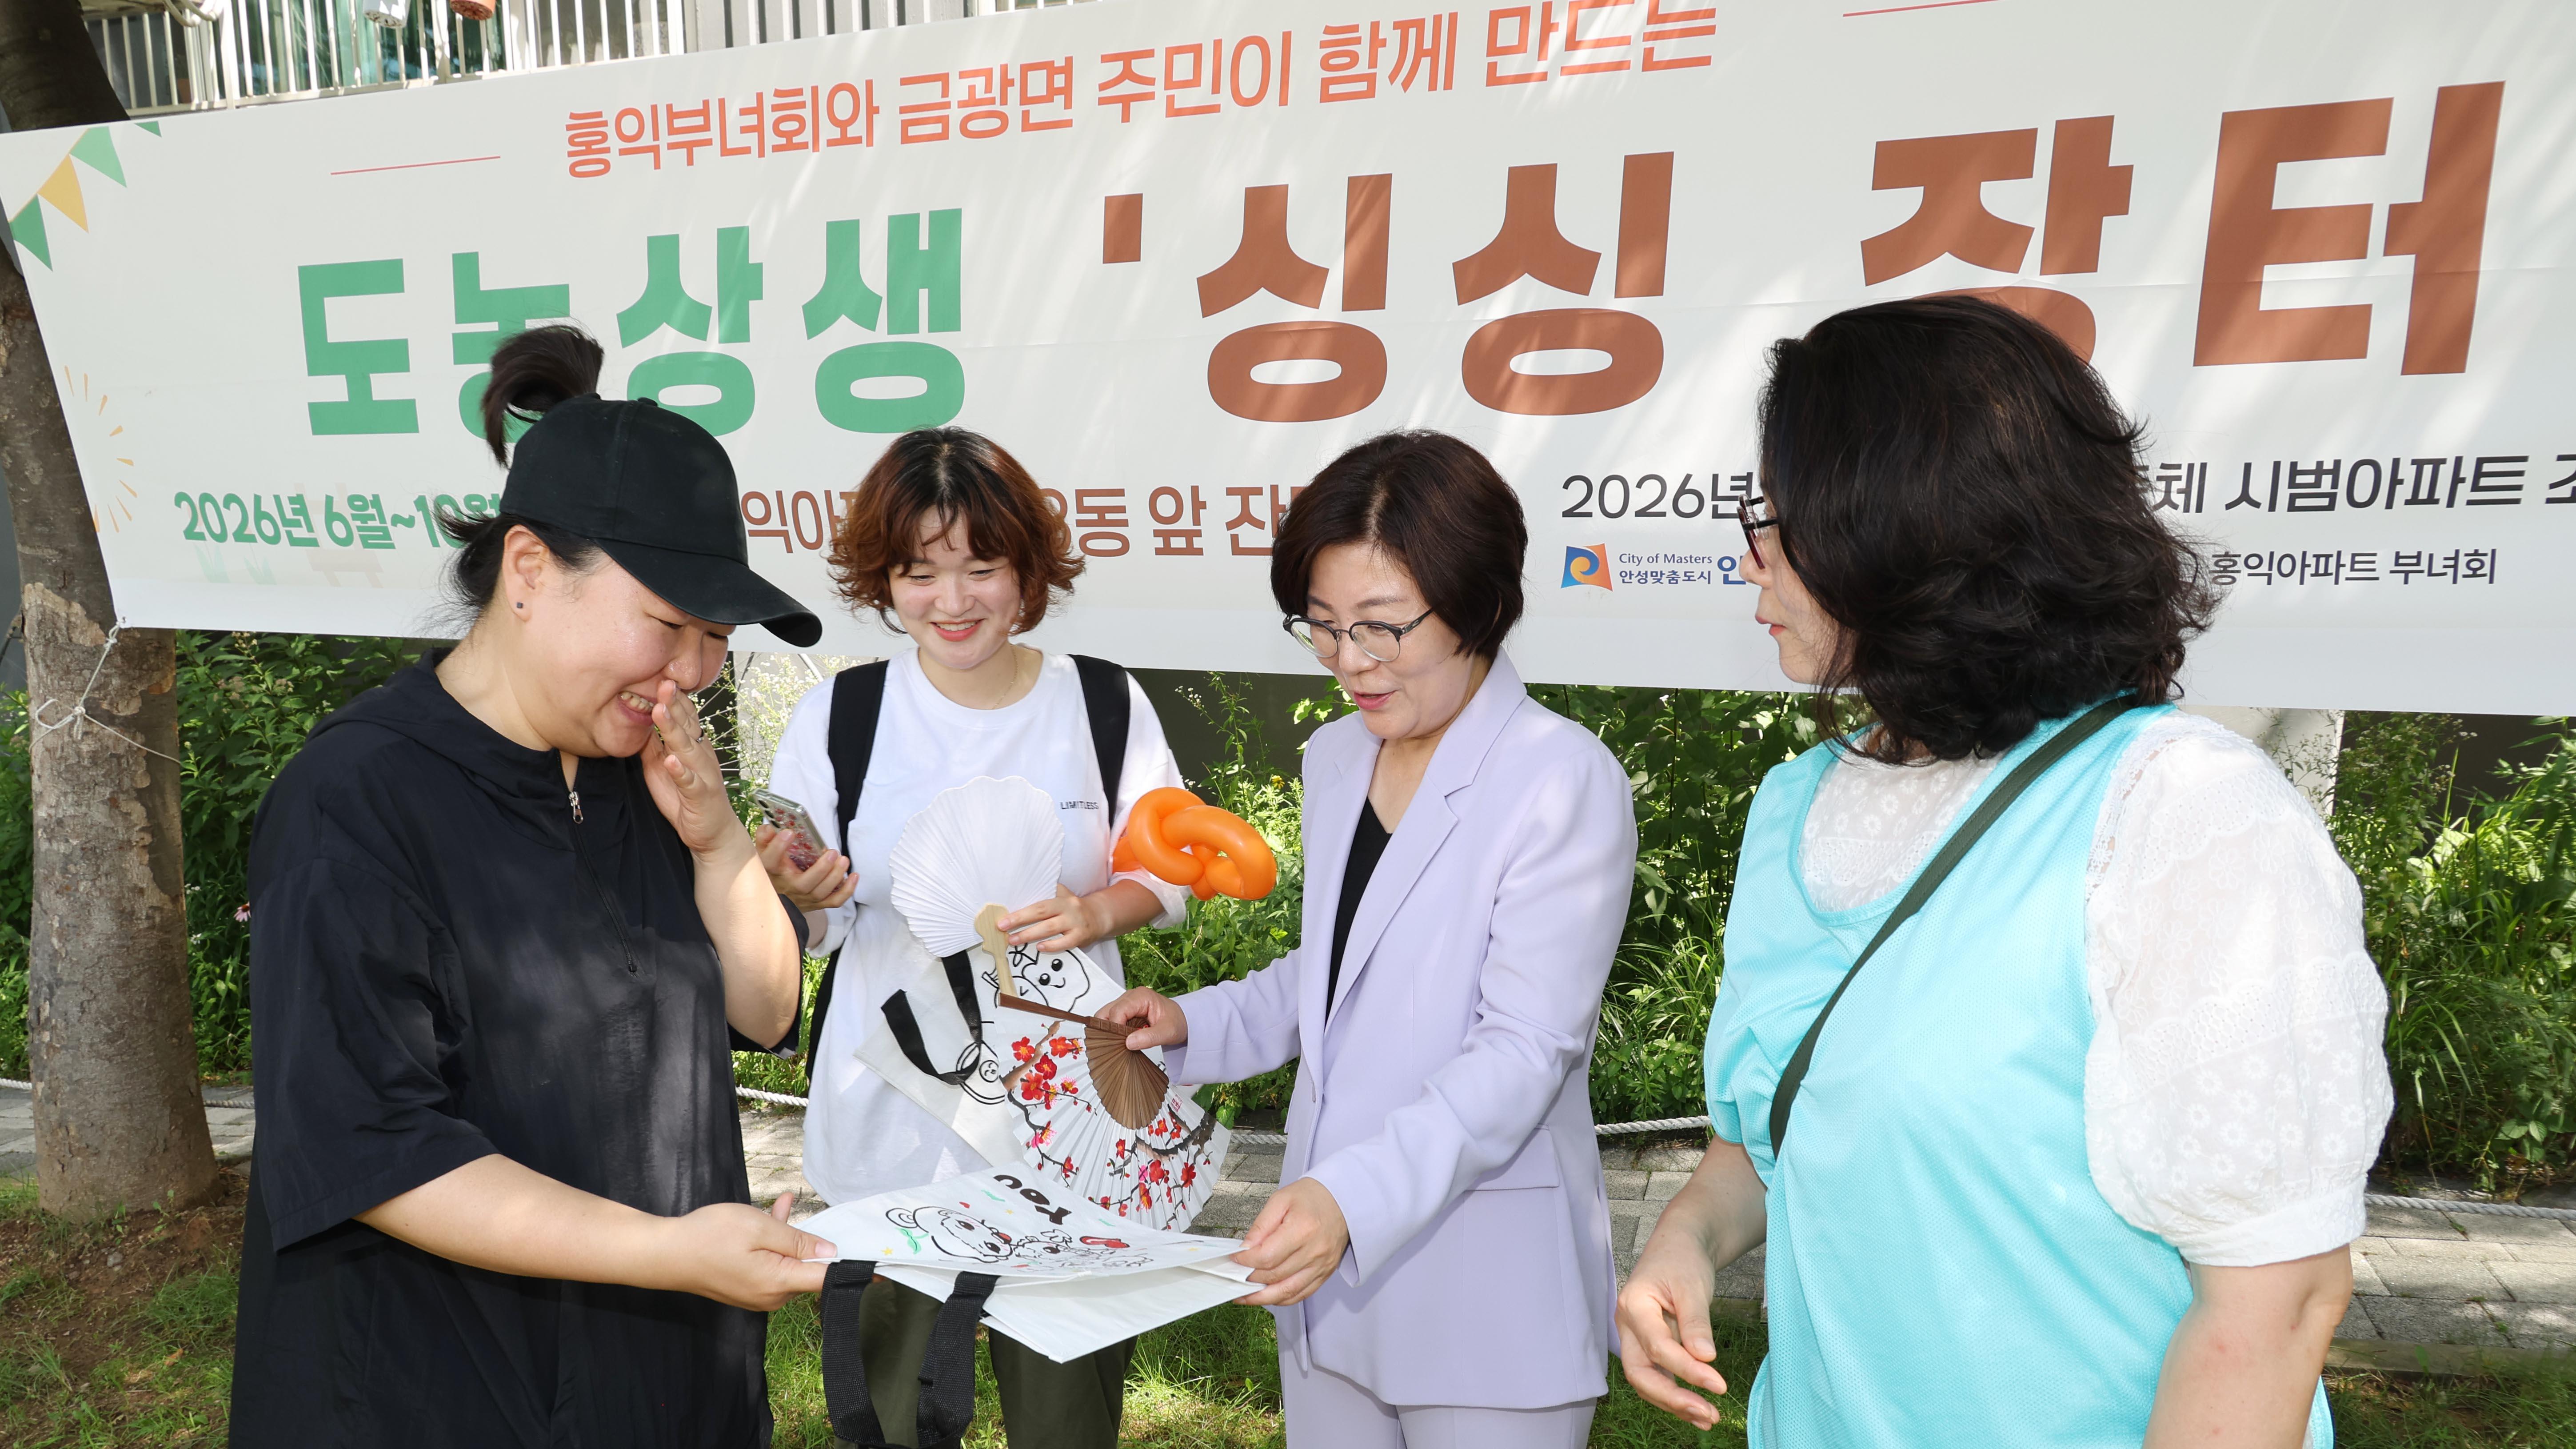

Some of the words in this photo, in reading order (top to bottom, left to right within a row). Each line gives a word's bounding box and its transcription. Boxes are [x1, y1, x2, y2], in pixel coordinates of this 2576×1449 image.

[565, 79, 880, 178] 홍익부녀회와
[899, 56, 1074, 145] 금광면
[1098, 31, 1292, 124] 주민이
[1319, 12, 1458, 104] 함께
[1486, 0, 1717, 87] 만드는
[1860, 80, 2506, 375] 장터
[1562, 471, 1753, 519] 2026년
[2133, 462, 2208, 513] 체
[2225, 455, 2529, 513] 시범아파트
[174, 491, 320, 548] 2026년
[1149, 485, 1207, 556] 앞
[1225, 484, 1308, 556] 잔
[1619, 553, 1643, 567] City
[1647, 553, 1660, 564] of
[1664, 554, 1713, 564] Masters
[1619, 570, 1711, 585] 안성맞춤도시
[2209, 550, 2380, 585] 홍익아파트
[2388, 548, 2497, 584] 부녀회
